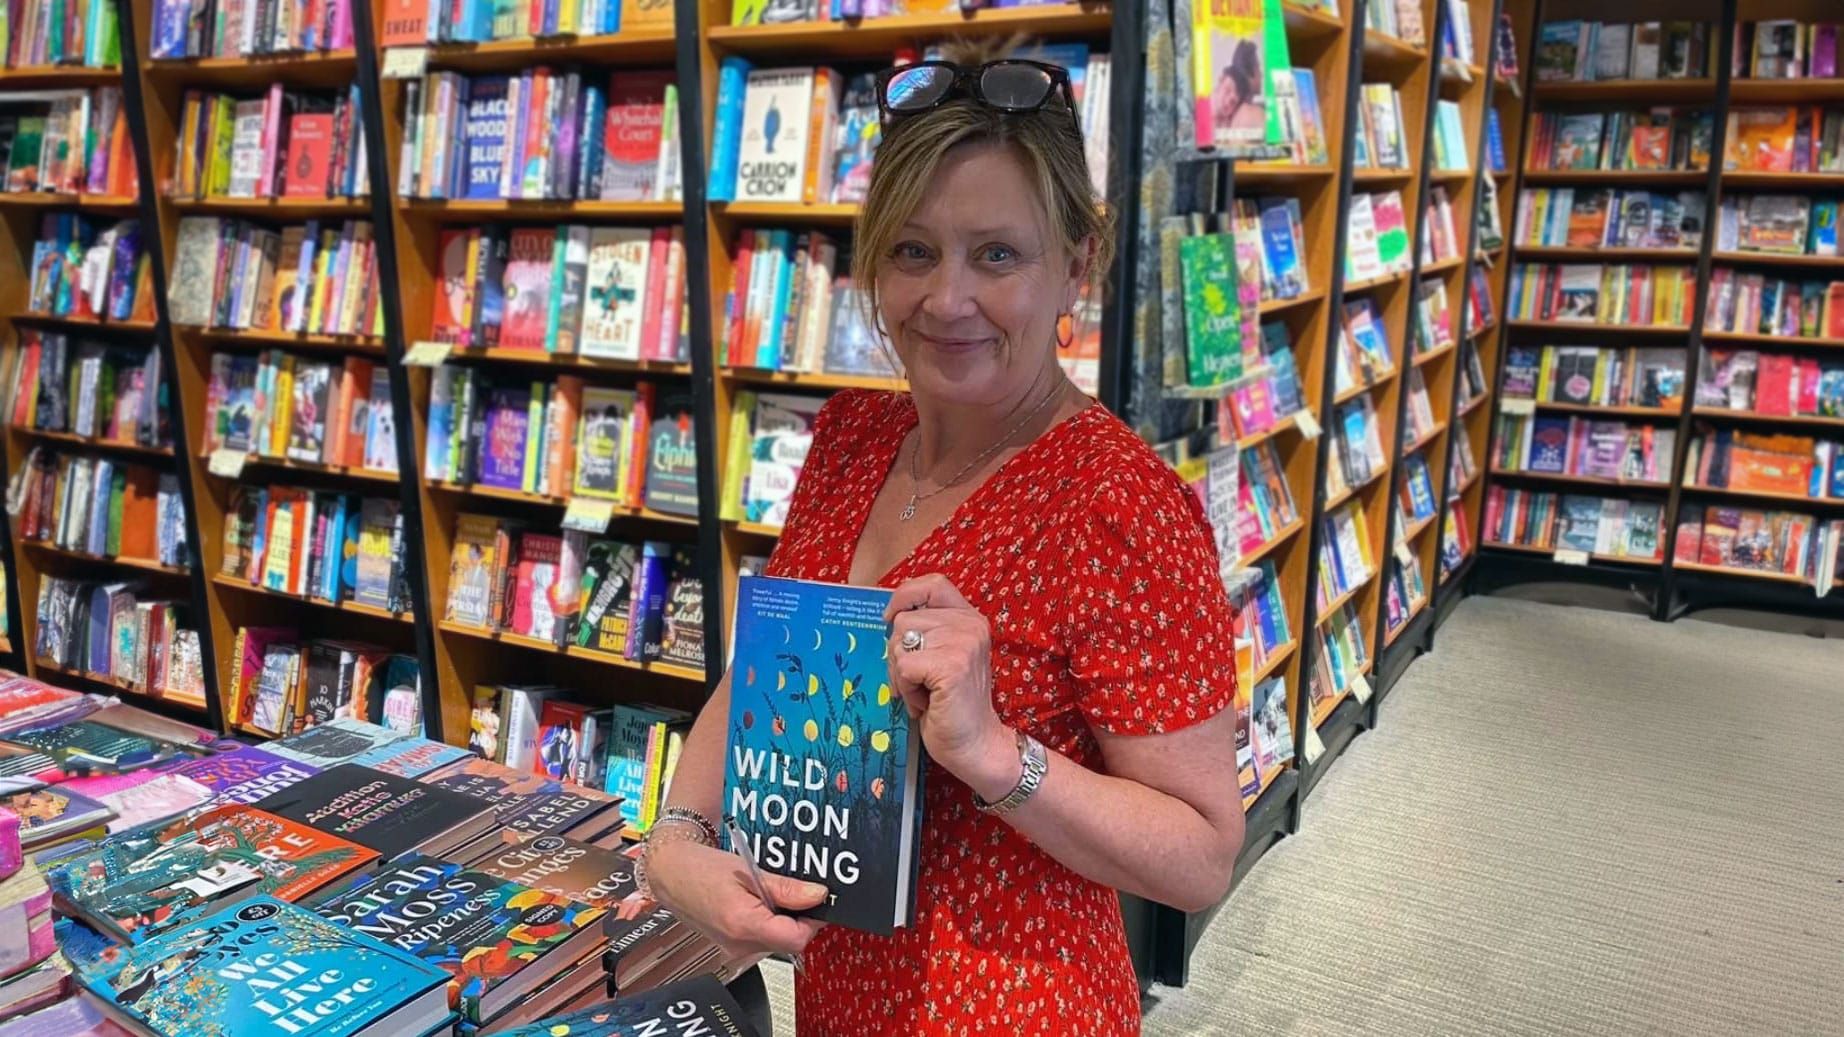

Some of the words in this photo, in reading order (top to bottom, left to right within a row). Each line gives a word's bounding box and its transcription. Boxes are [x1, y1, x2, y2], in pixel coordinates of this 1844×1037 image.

[470, 100, 509, 118] BLAC
[467, 121, 505, 138] WOOD
[740, 162, 797, 179] CARRION
[746, 179, 786, 196] CROW
[654, 431, 697, 472] Elphi
[523, 538, 562, 553] CHRISTI
[734, 745, 828, 791] WILD
[731, 787, 849, 840] MOON
[497, 842, 556, 870] Cit
[393, 888, 501, 951] Ripeness
[537, 908, 559, 925] COPY
[218, 952, 280, 981] We
[247, 960, 311, 998] All
[251, 969, 345, 1017] Live
[271, 978, 377, 1034] Here
